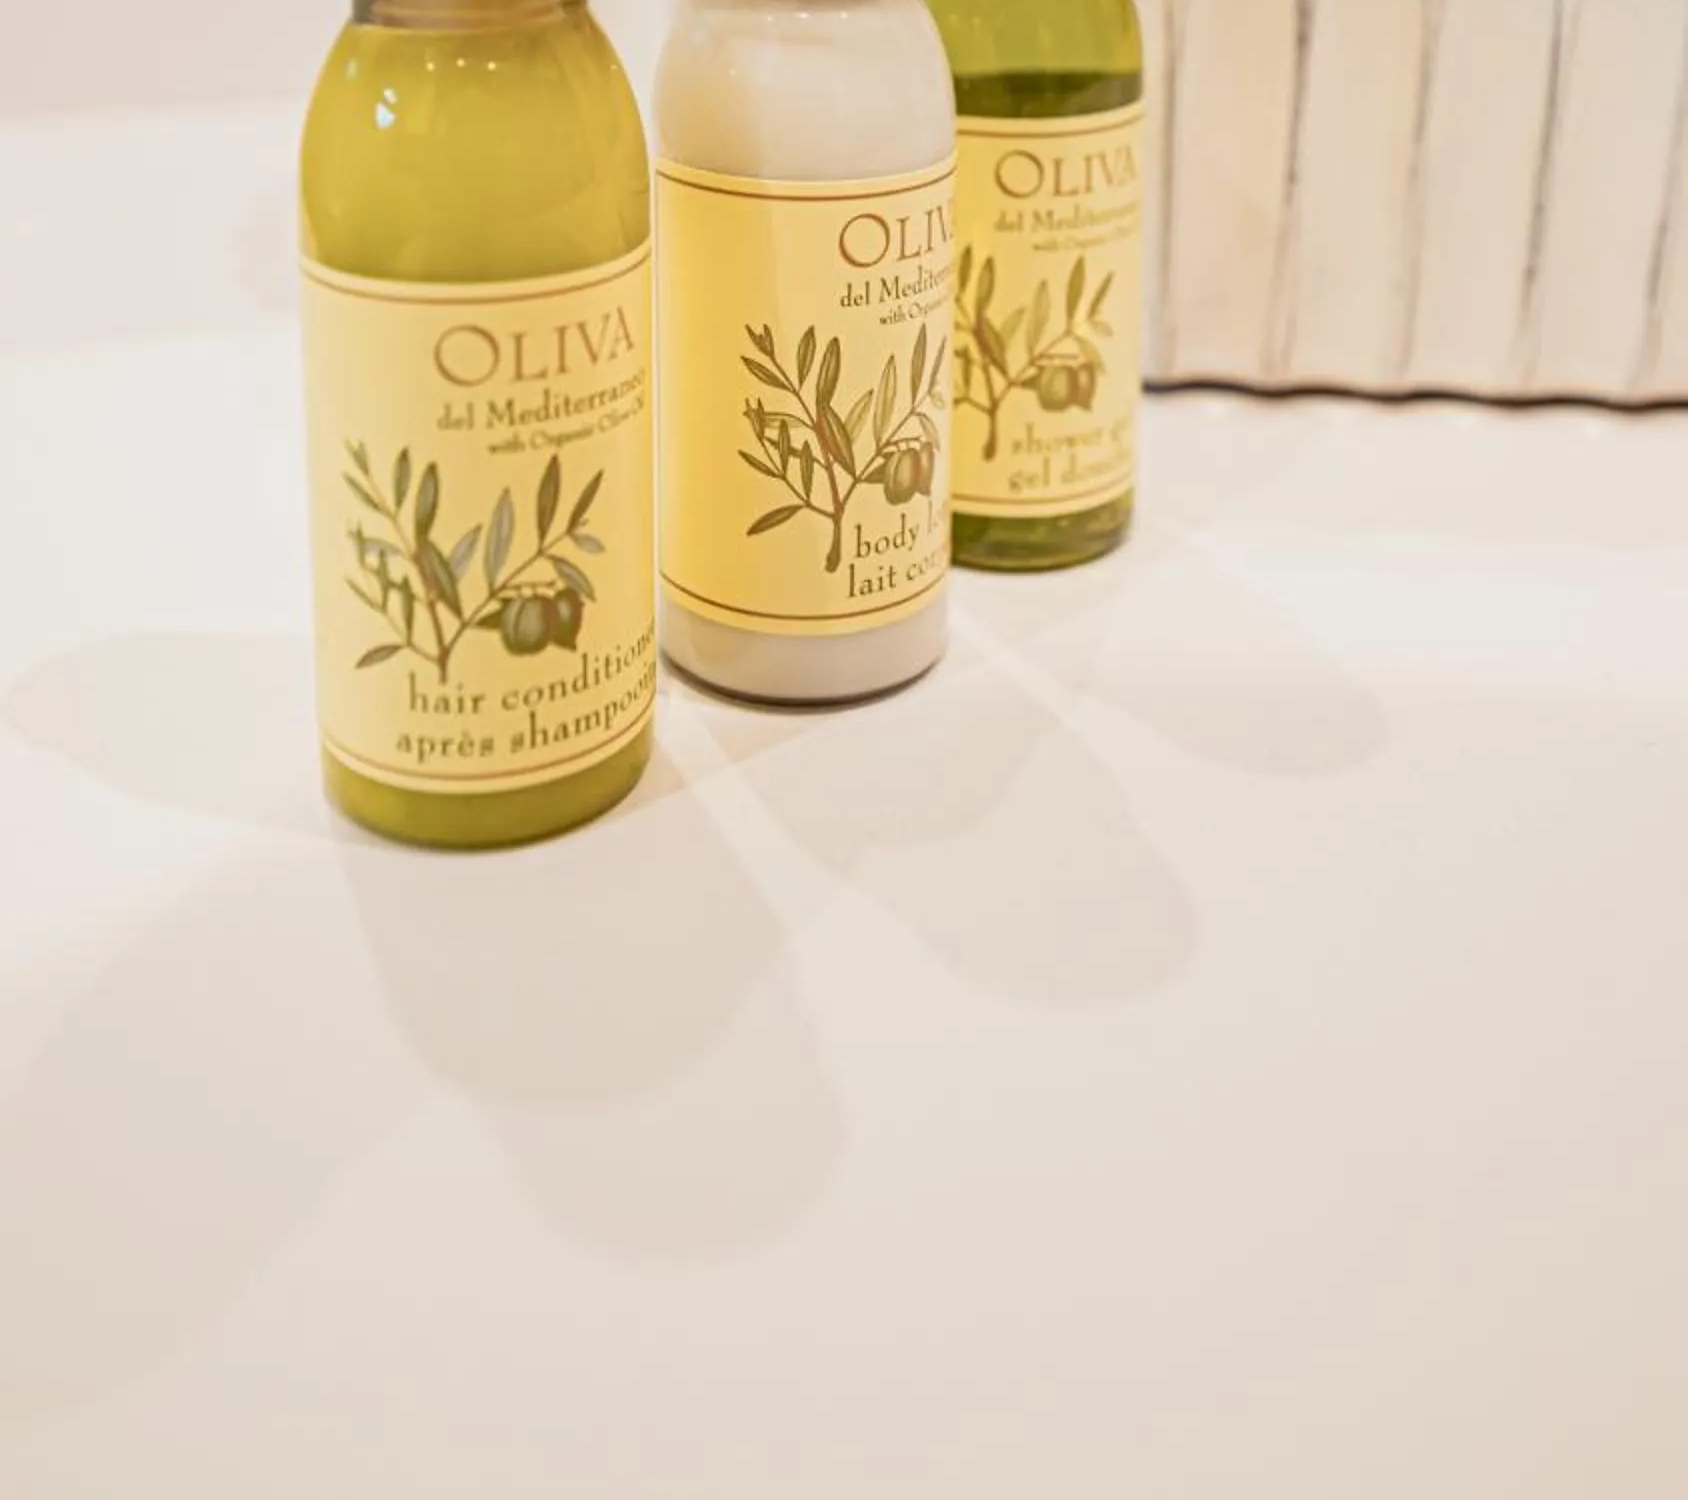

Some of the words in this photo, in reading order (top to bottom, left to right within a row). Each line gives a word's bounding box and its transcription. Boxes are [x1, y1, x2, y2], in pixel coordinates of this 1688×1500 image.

[993, 142, 1138, 199] OLIVA
[838, 204, 953, 269] OLIV
[840, 281, 869, 308] del
[433, 305, 636, 388] OLIVA
[436, 401, 475, 431] del
[854, 512, 920, 559] body
[847, 563, 897, 599] lait
[408, 670, 486, 716] hair
[396, 728, 495, 764] après
